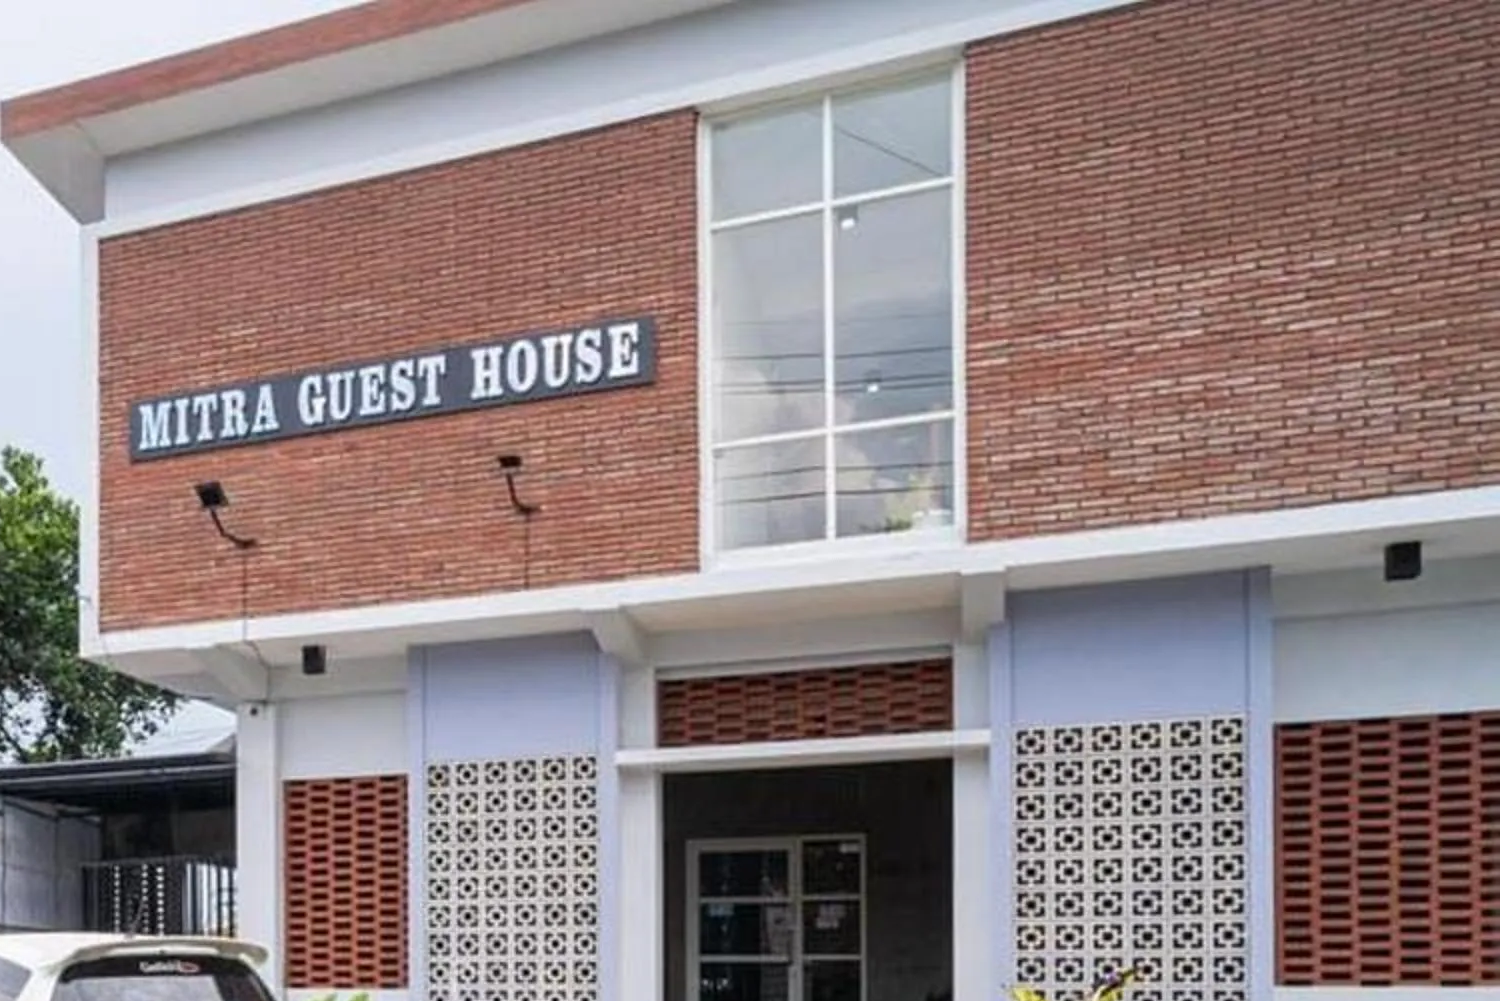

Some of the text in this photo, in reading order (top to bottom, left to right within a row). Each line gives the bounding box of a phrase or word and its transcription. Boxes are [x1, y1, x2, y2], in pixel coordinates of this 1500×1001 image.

[139, 323, 640, 450] MITRA GUEST HOUSE
